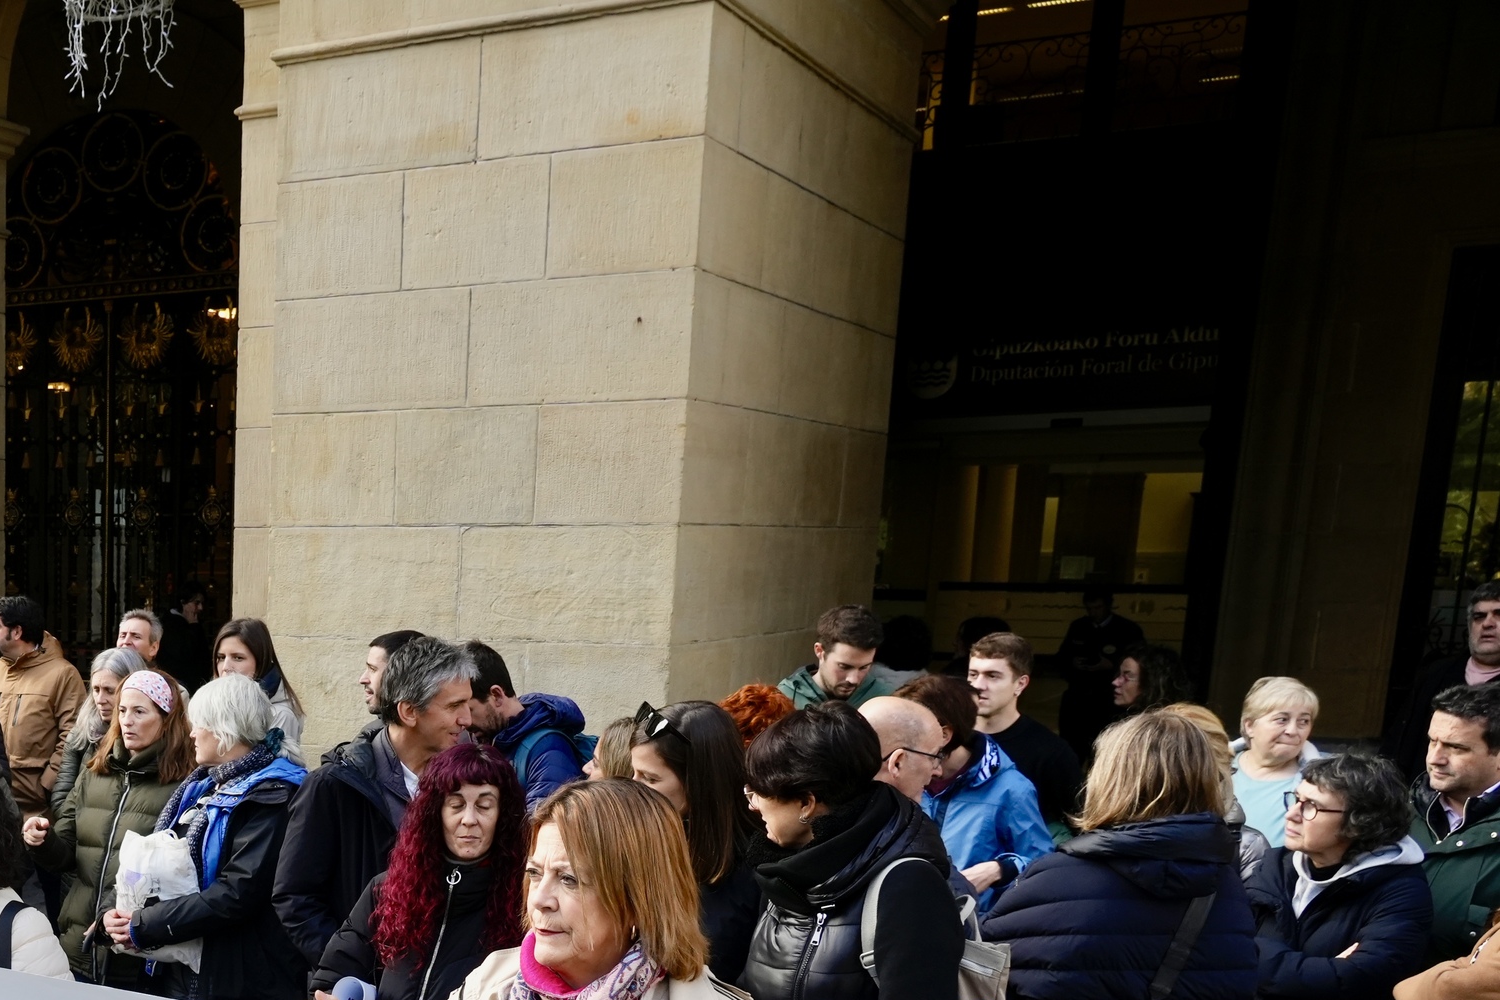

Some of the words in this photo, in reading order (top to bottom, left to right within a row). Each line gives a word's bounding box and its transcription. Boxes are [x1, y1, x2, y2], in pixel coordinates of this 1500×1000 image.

[1103, 329, 1160, 349] Foru
[970, 358, 1076, 387] Diputación
[1079, 353, 1132, 377] Foral
[1137, 352, 1164, 374] de
